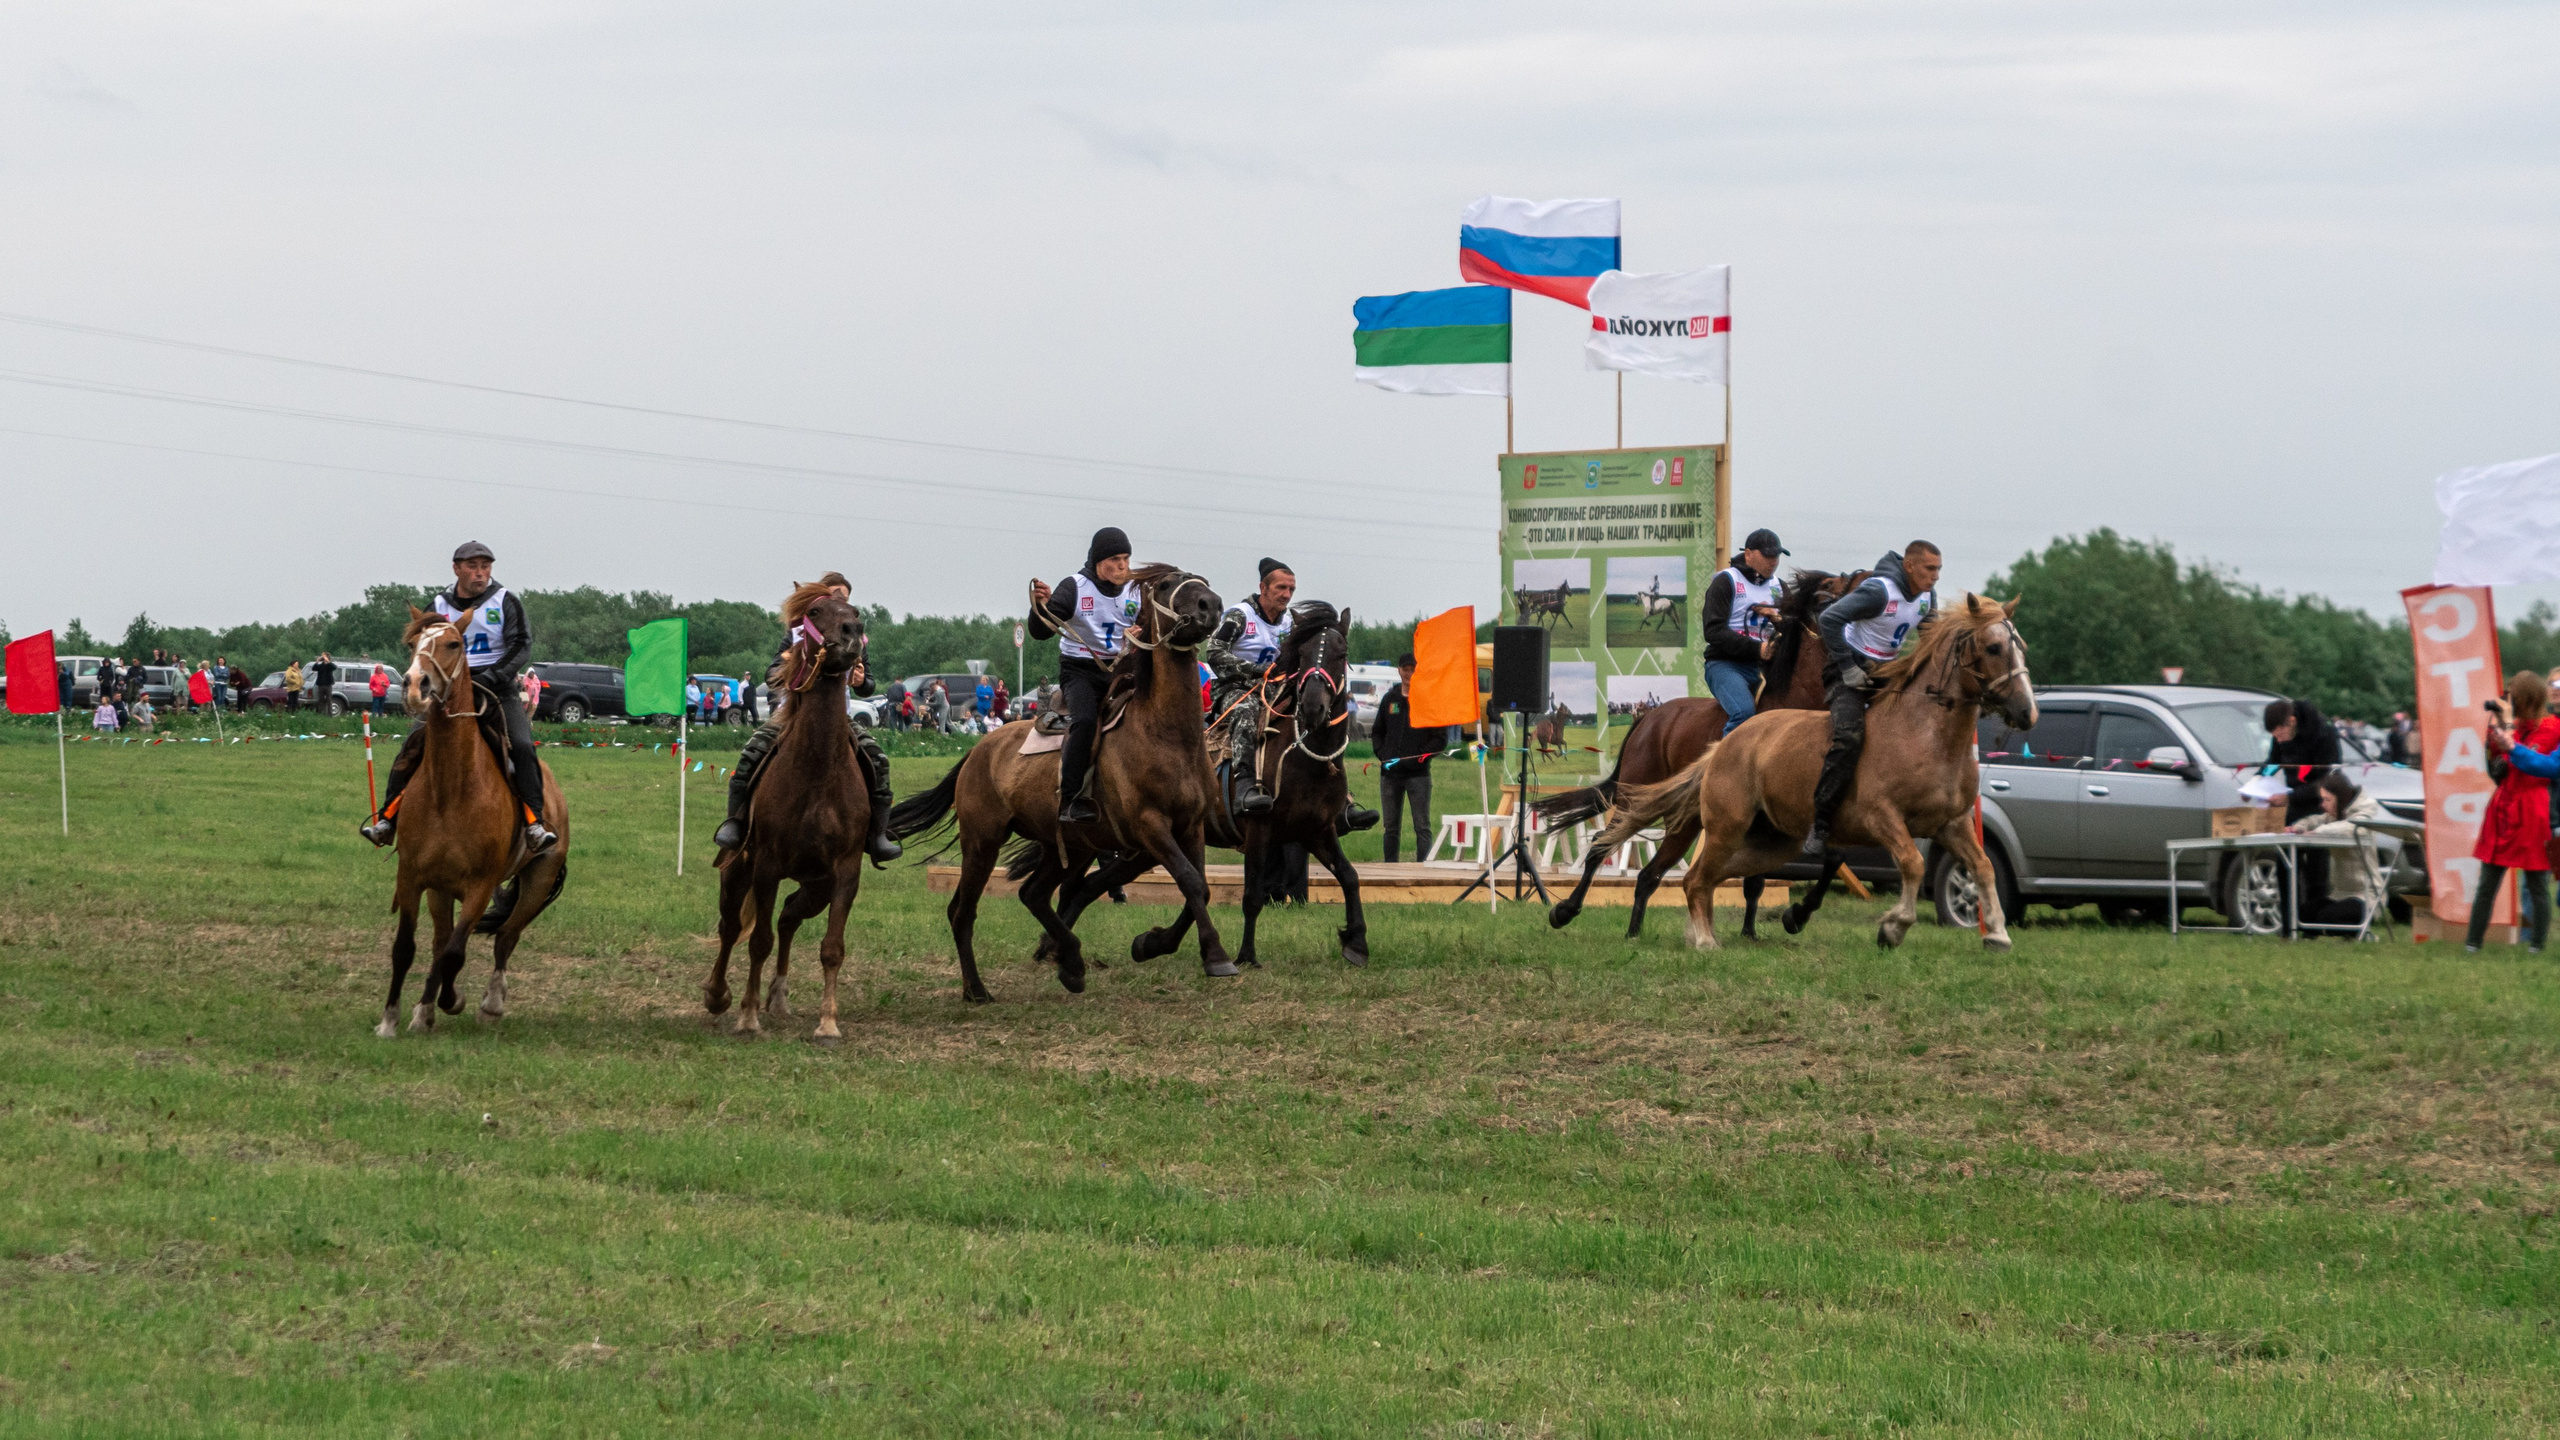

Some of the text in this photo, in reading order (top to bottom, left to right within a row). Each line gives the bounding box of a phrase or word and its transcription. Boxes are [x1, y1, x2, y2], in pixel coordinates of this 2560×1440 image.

[1508, 502, 1702, 523] КОННОСПОРТИВНЫЕ СОРЕВНОВАНИЯ В ИЖМЕ
[1528, 528, 1543, 543] ЭТО
[1545, 527, 1566, 542] СИЛА
[1569, 527, 1575, 542] И
[1577, 526, 1605, 543] МОЩЬ
[1607, 525, 1640, 541] НАШИХ
[1643, 520, 1695, 542] ТРАДИЦИЙ
[1102, 622, 1115, 649] 7
[1890, 622, 1910, 648] 9
